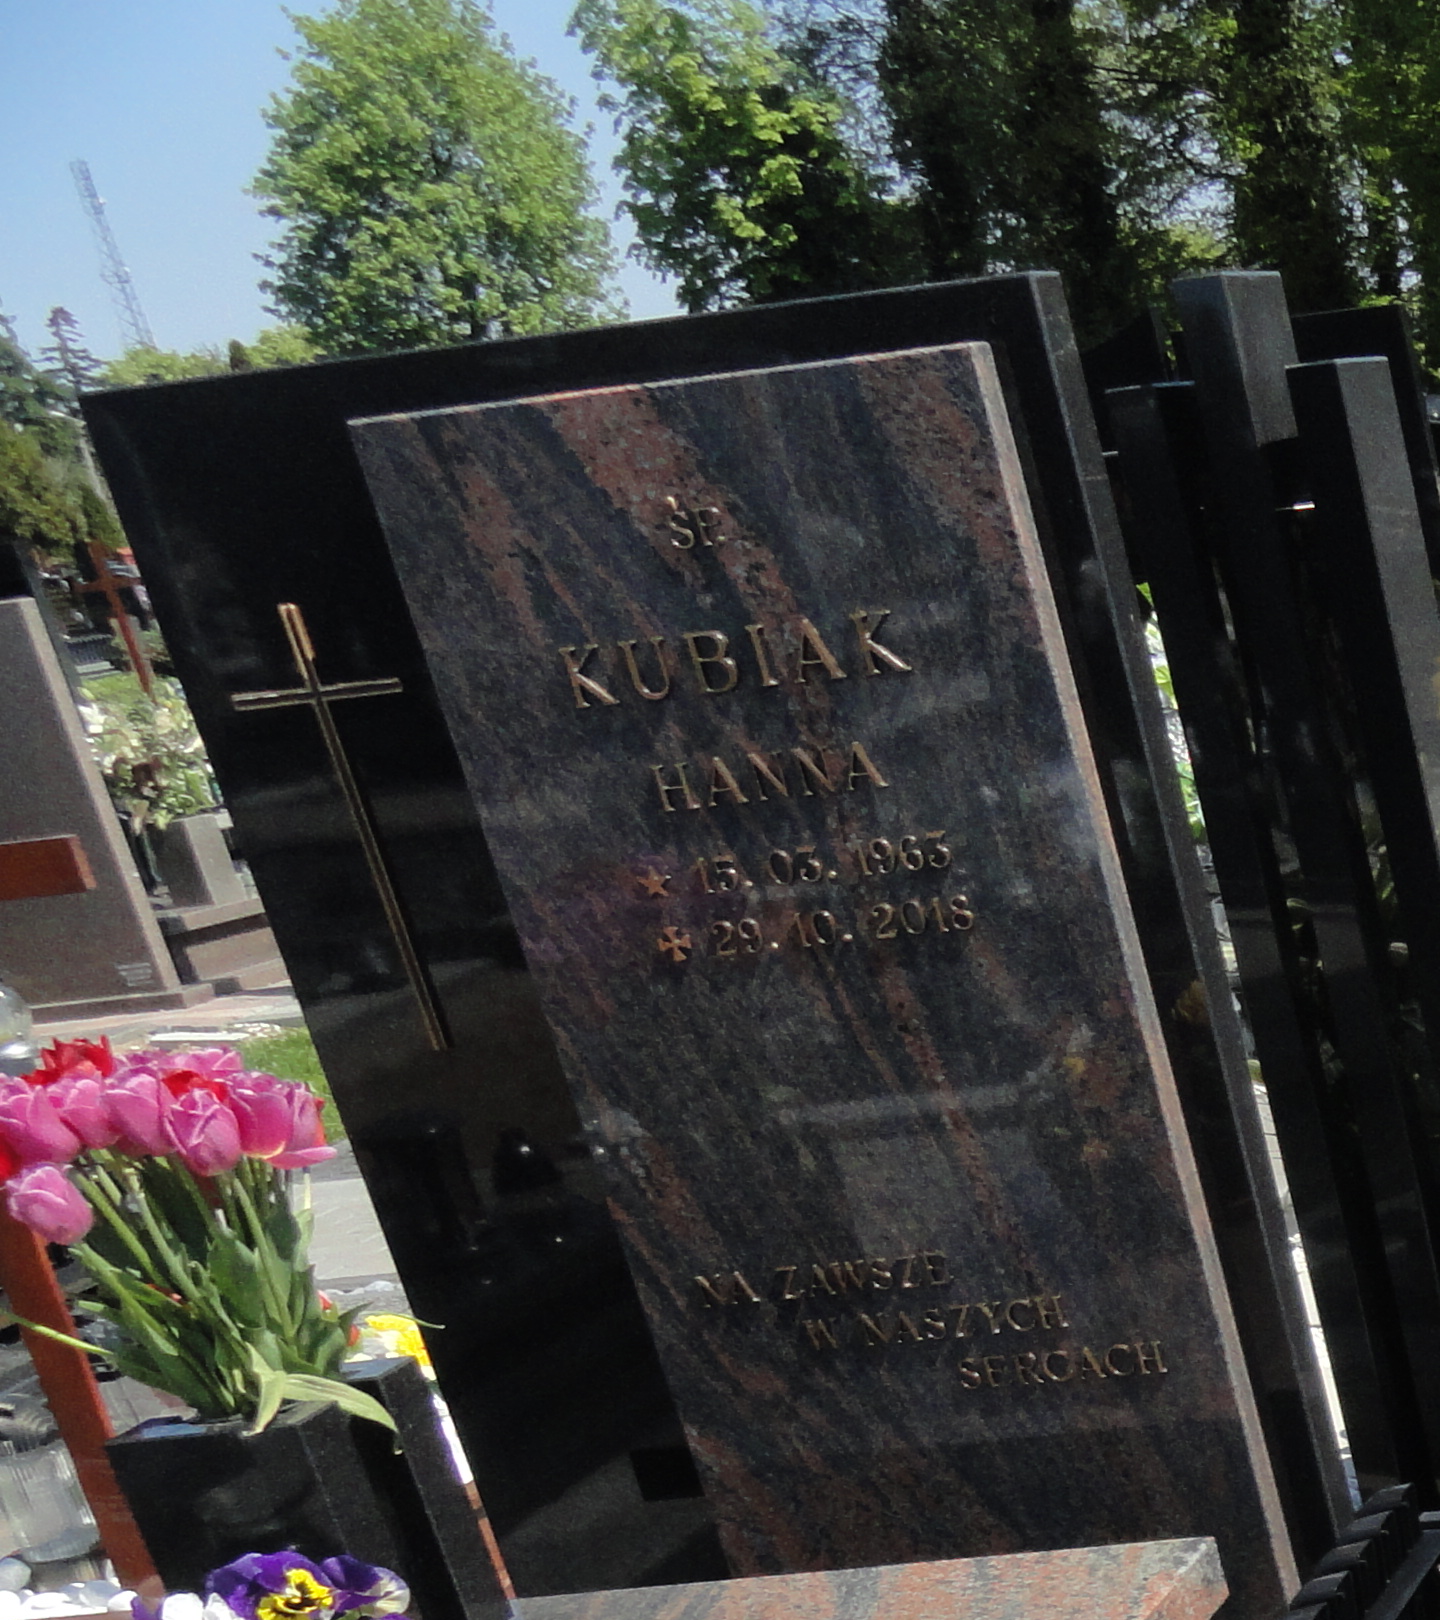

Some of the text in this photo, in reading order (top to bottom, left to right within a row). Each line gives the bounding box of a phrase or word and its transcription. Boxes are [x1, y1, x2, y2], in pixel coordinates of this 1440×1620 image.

[559, 609, 913, 711] KUBIAK
[652, 740, 889, 812] HANNA
[693, 1250, 954, 1308] NA ZAWSZE
[801, 1295, 1070, 1351] W NASZYCH
